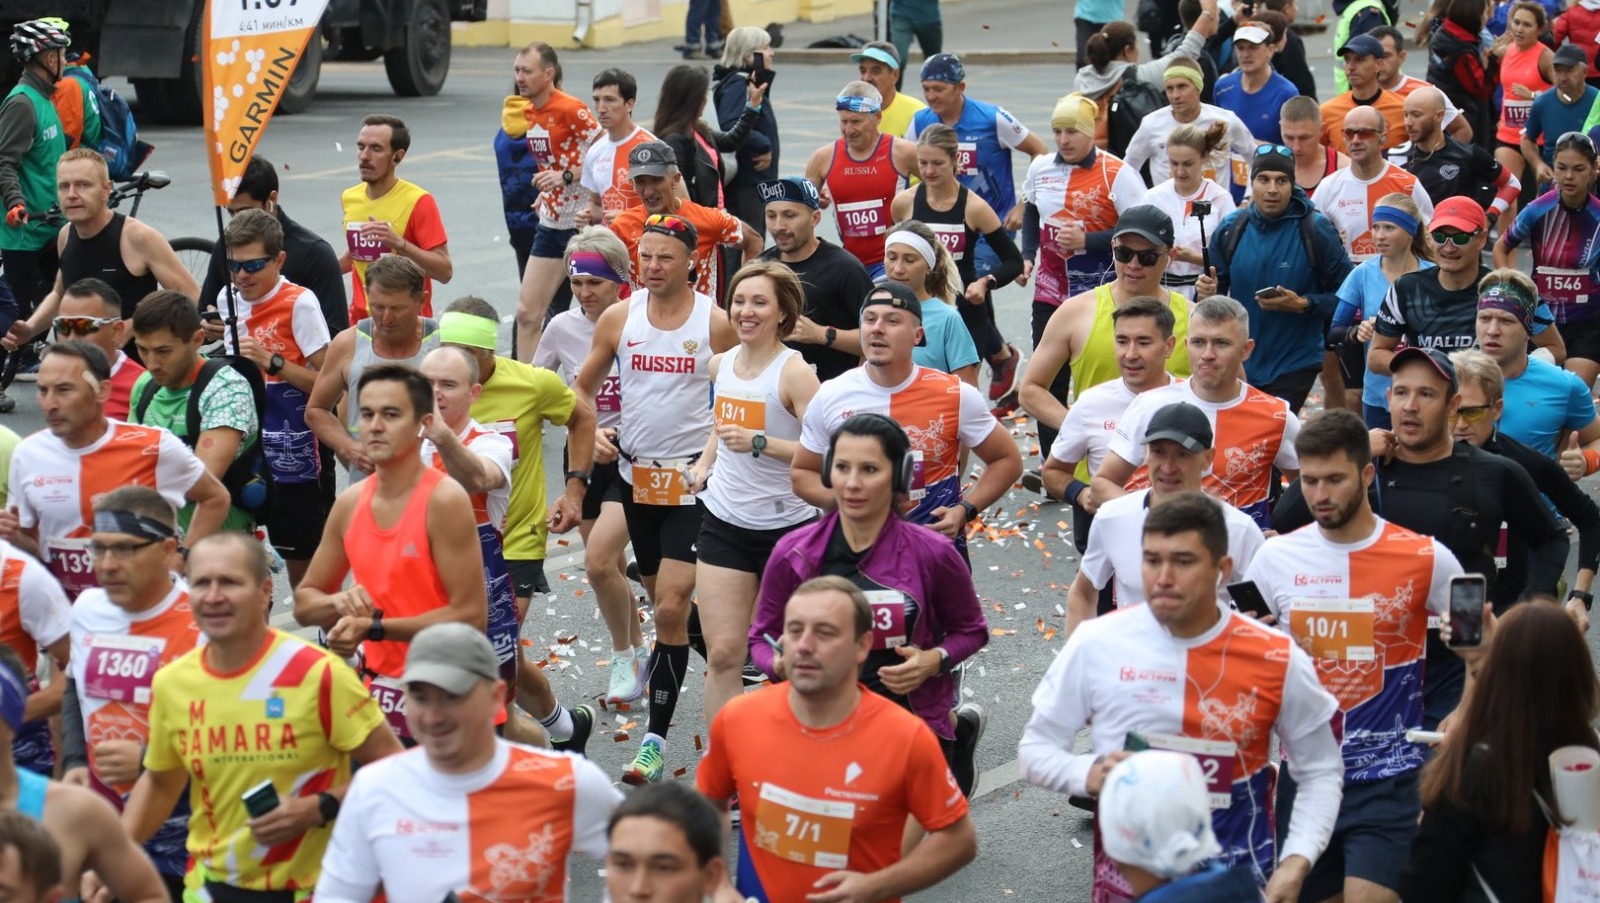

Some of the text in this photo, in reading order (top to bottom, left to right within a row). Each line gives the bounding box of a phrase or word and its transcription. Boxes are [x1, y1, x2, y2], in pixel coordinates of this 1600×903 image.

[229, 47, 296, 163] GARMIN
[529, 140, 547, 152] 1208
[844, 166, 877, 175] RUSSIA
[845, 210, 878, 226] 1060
[1545, 276, 1582, 291] 1546
[632, 354, 695, 374] RUSSIA
[721, 401, 745, 421] 13/1
[650, 471, 673, 489] 37
[872, 607, 893, 630] 3
[1306, 616, 1347, 639] 10/1
[97, 651, 149, 679] 1360
[178, 723, 298, 757] SAMARA
[785, 813, 820, 842] 7/1
